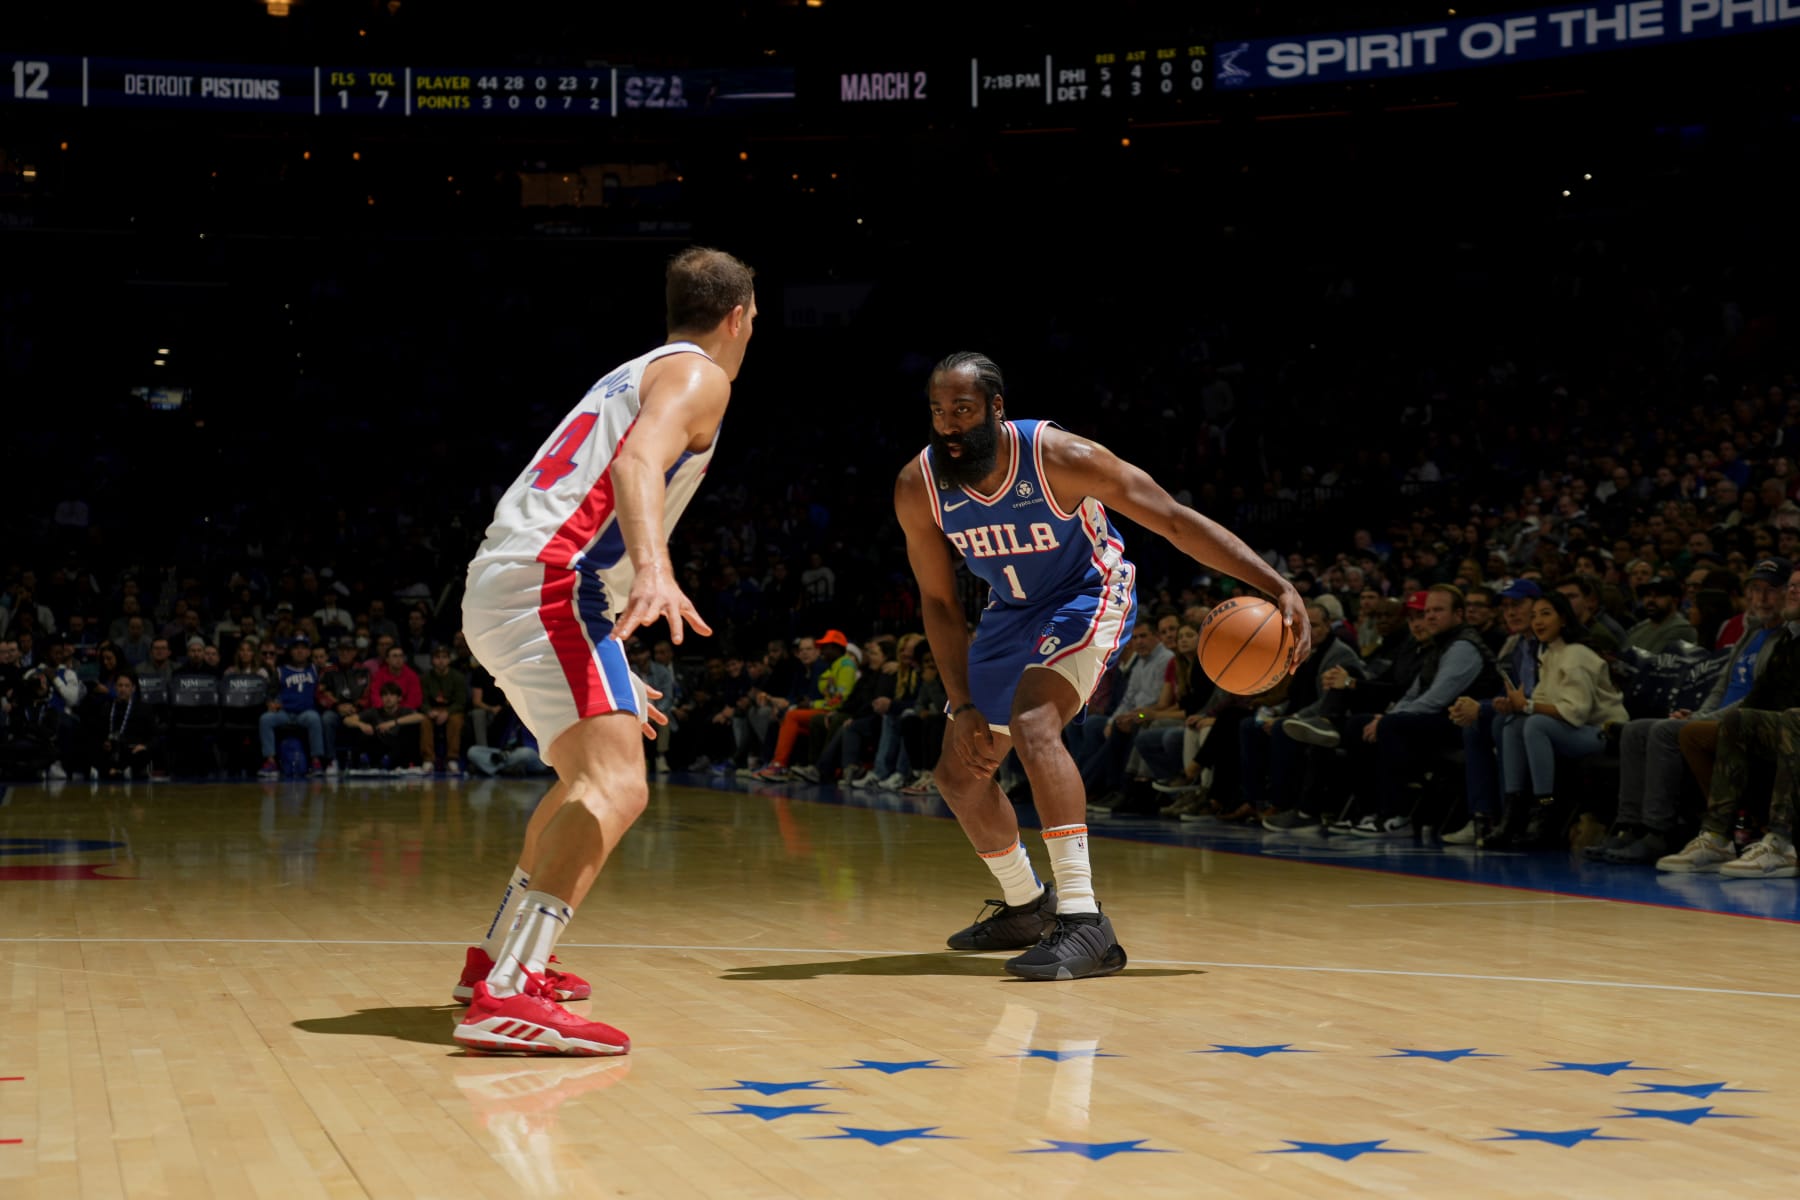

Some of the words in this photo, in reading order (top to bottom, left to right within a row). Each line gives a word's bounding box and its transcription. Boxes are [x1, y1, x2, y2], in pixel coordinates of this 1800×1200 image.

[1266, 27, 1448, 79] SPIRIT
[1459, 15, 1537, 60] OF
[1548, 0, 1665, 49] THE
[11, 60, 50, 100] 12
[330, 72, 356, 87] FLS
[368, 72, 396, 87] TOL
[416, 75, 471, 91] PLAYER
[477, 76, 498, 90] 44
[503, 76, 525, 90] 28
[534, 76, 547, 91] 0
[558, 76, 578, 90] 23
[589, 76, 599, 90] 7
[1015, 73, 1042, 88] PM
[1058, 68, 1087, 85] PHI
[1100, 66, 1112, 82] 5
[1130, 63, 1143, 79] 4
[1160, 61, 1173, 77] 0
[1190, 58, 1204, 74] 0
[124, 73, 193, 97] DETROIT
[201, 77, 280, 100] PISTONS
[338, 89, 348, 109] 1
[375, 90, 389, 109] 7
[841, 72, 910, 102] MARCH
[914, 71, 927, 100] 2
[1056, 84, 1088, 102] DET
[1100, 83, 1113, 99] 4
[1130, 81, 1142, 97] 3
[1160, 78, 1173, 94] 0
[1190, 76, 1204, 92] 0
[416, 95, 471, 110] POINTS
[481, 95, 492, 109] 3
[508, 95, 521, 110] 0
[534, 95, 547, 110] 0
[562, 95, 573, 109] 7
[589, 96, 600, 110] 2
[529, 411, 600, 491] 4
[946, 522, 1060, 559] PHILA
[1003, 564, 1027, 601] 1
